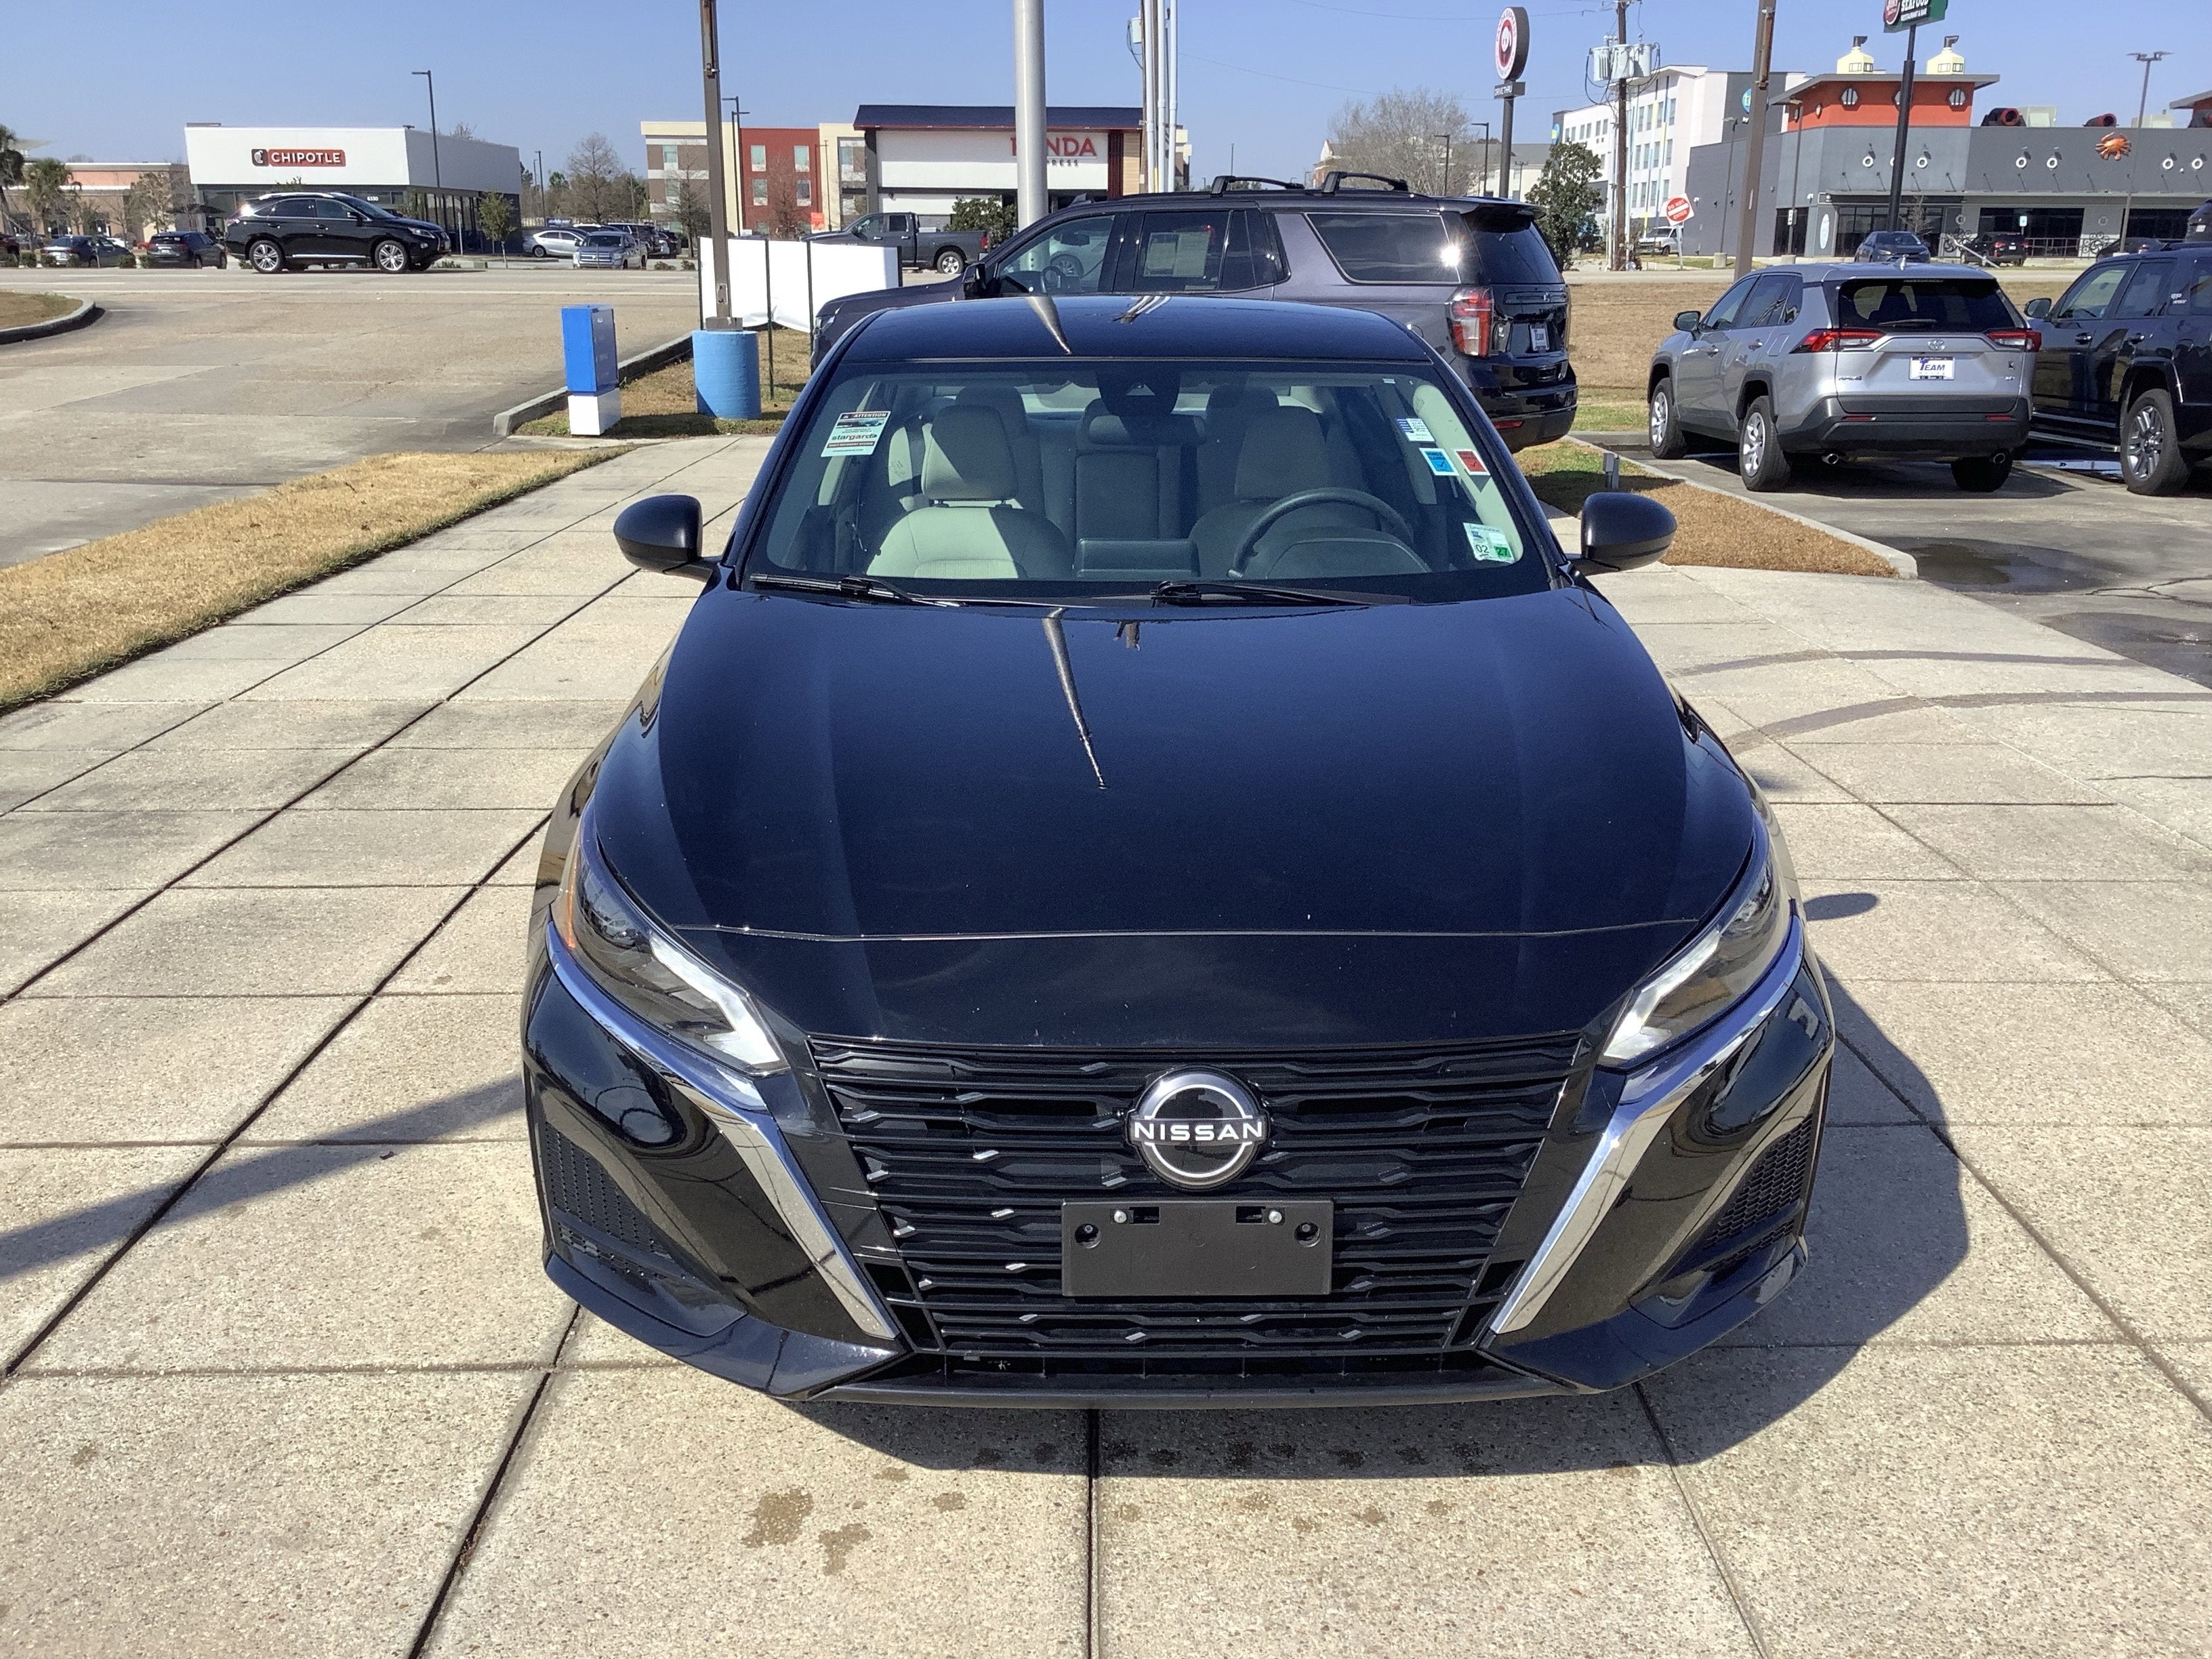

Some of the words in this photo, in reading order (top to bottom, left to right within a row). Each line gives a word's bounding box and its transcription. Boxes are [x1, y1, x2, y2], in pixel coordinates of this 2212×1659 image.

[271, 152, 342, 163] CHIPOTLE
[1919, 359, 1946, 371] TEAM
[1475, 544, 1490, 554] 02
[1496, 547, 1508, 556] 27
[1134, 1122, 1263, 1141] NISSAN
